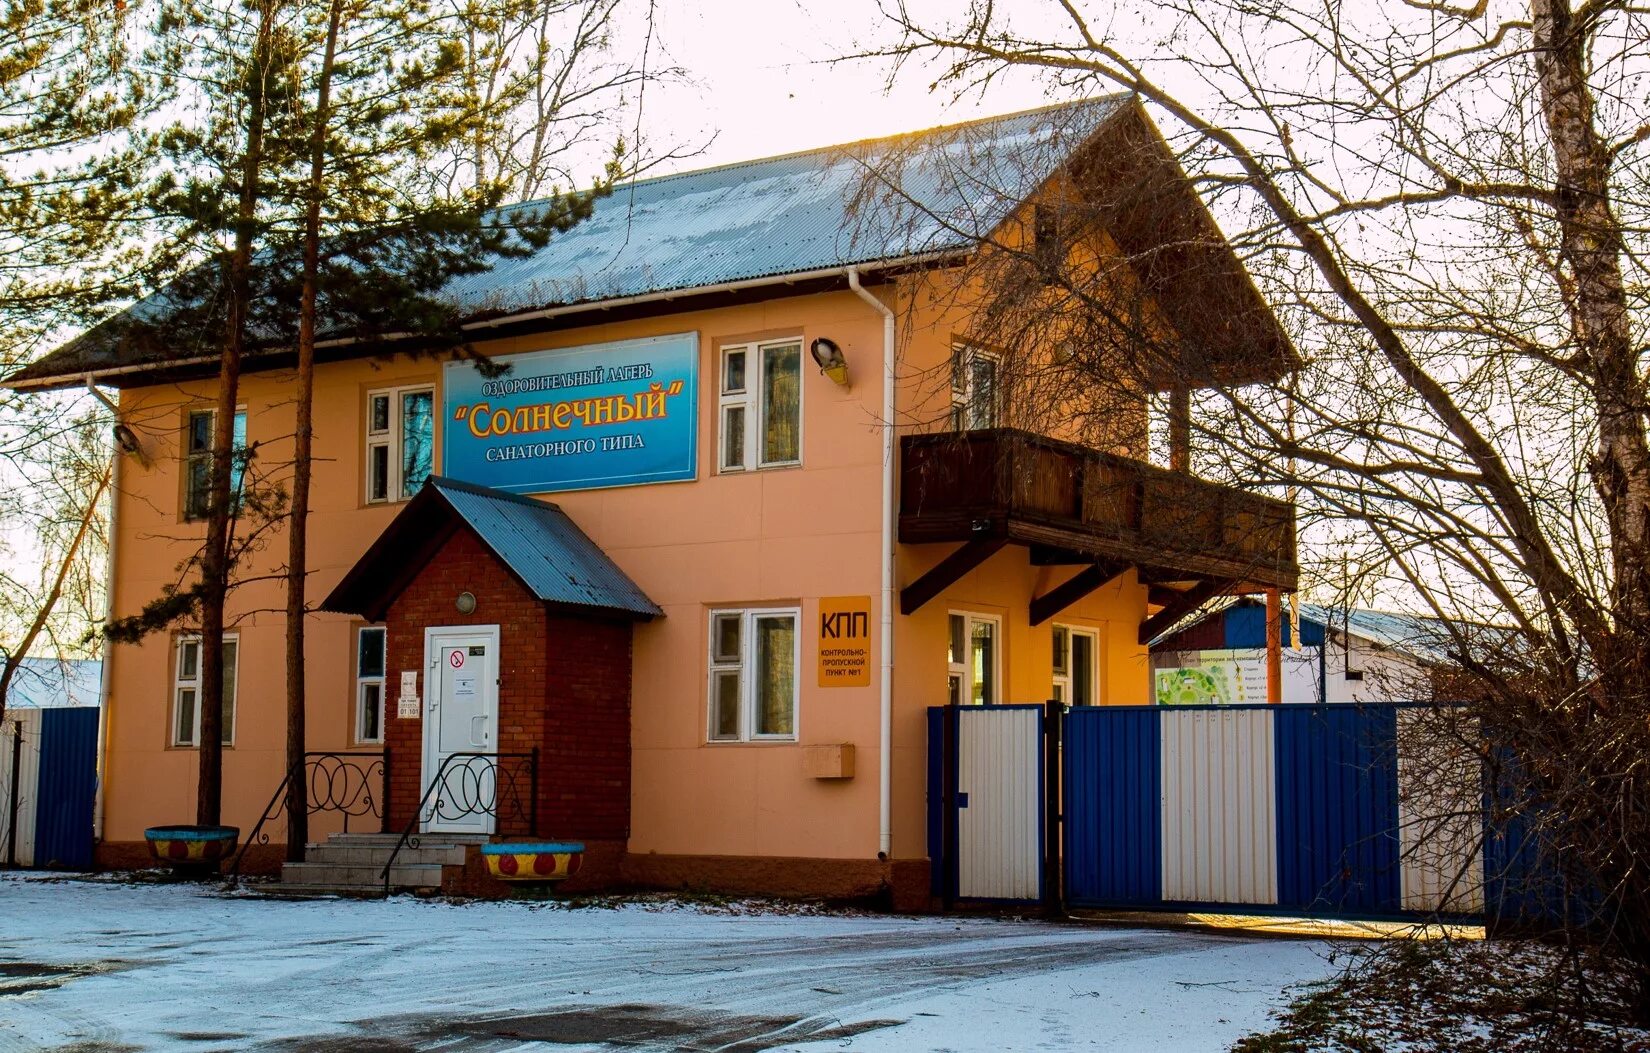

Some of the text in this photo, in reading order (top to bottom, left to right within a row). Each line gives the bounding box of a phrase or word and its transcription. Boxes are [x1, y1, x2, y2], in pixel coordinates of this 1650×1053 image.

[482, 363, 653, 397] ОЗДОРОВИТЕЛЬНЫЙ ЛАГЕРЬ
[486, 434, 644, 462] САНАТОРНОГО ТИПА
[822, 611, 867, 638] КПП
[822, 658, 865, 666] ПРОПУСКНОЙ
